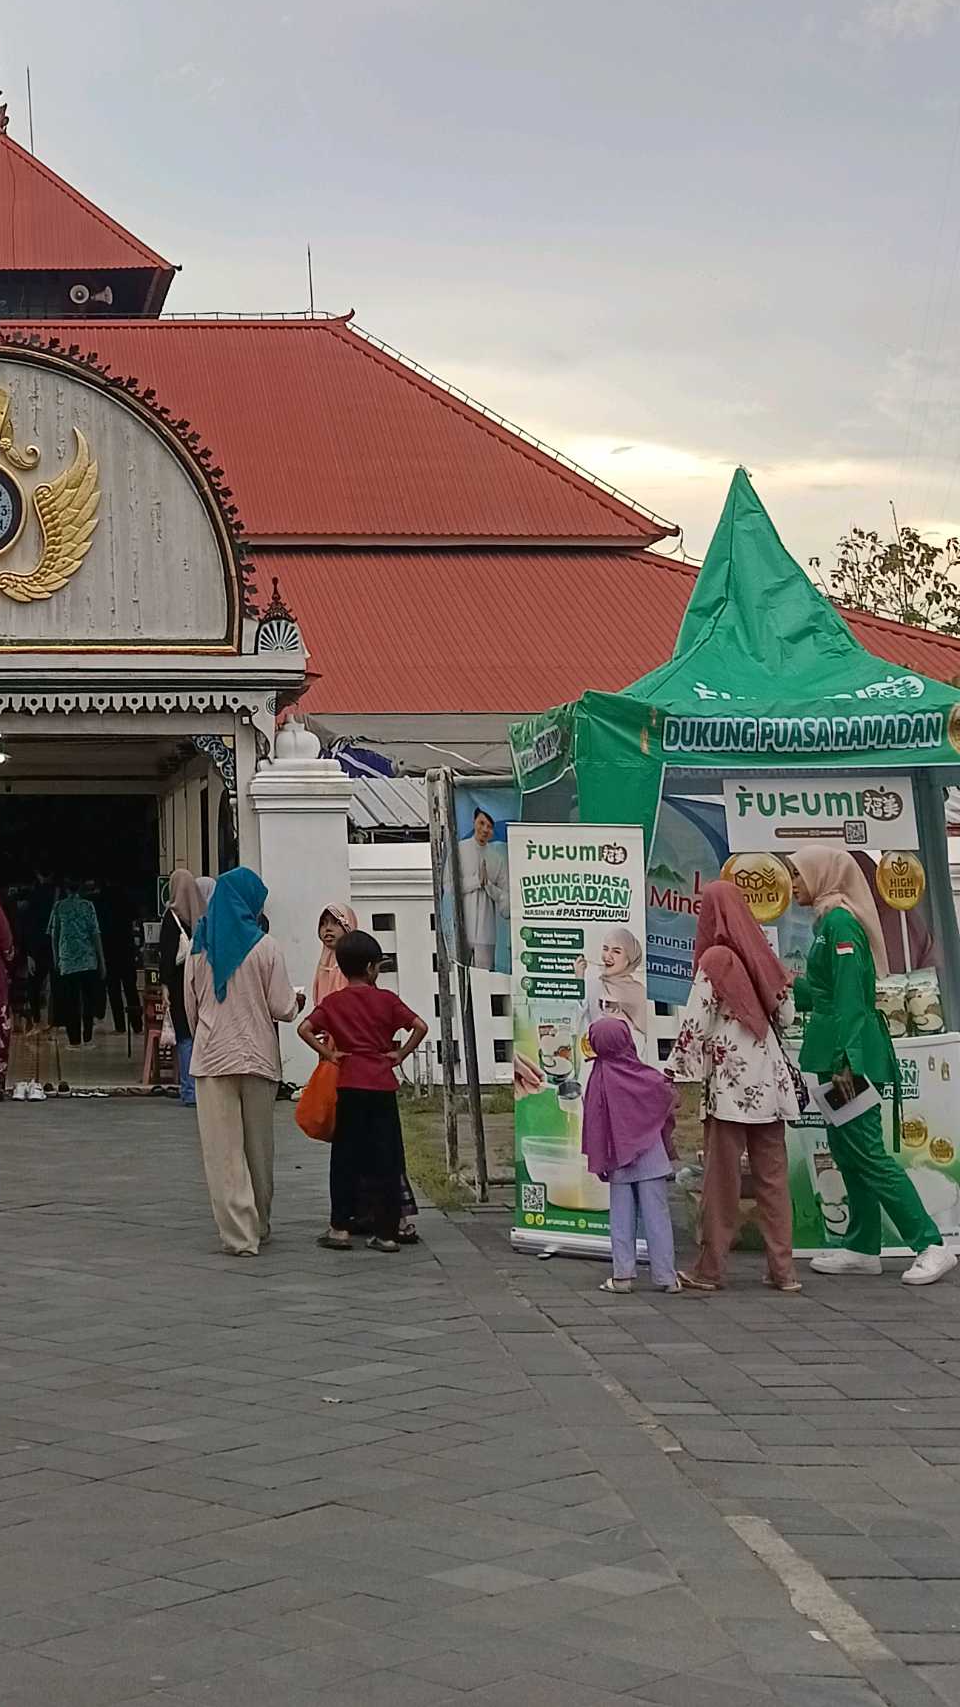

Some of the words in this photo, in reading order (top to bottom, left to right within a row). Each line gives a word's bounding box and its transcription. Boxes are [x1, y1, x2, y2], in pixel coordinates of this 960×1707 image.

[0, 505, 8, 516] 3
[665, 718, 758, 751] DUKUNG
[760, 718, 831, 750] PUASA
[837, 712, 942, 748] RAMADAN
[735, 787, 865, 817] FUKUMI
[526, 840, 603, 861] FUKUMI
[521, 874, 580, 887] DUKUNG
[583, 874, 630, 889] PUASA
[889, 878, 913, 887] HIGH
[523, 886, 629, 906] RAMADAN
[649, 886, 703, 915] Mine
[743, 893, 762, 903] OW
[767, 892, 779, 903] GI
[889, 888, 917, 898] FIBER
[556, 908, 628, 918] #PASTIFUKUMI
[646, 933, 696, 951] enunai
[646, 959, 694, 977] amadha
